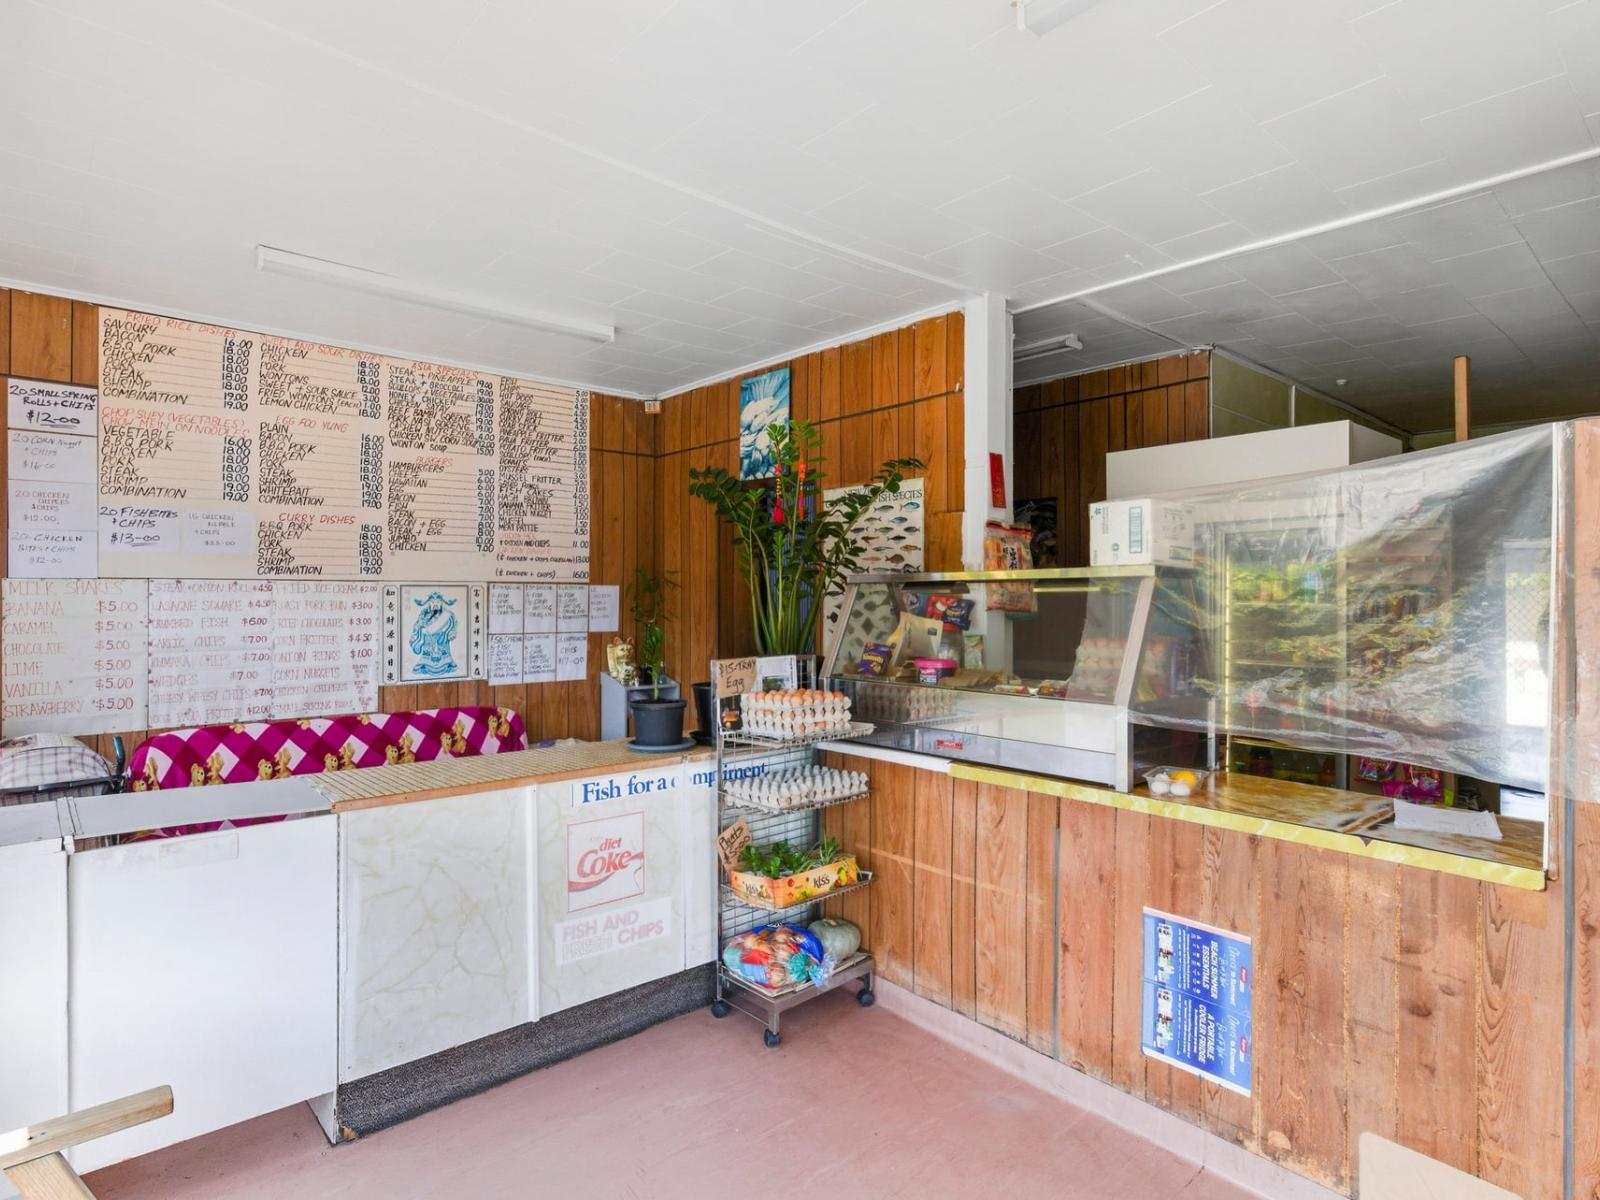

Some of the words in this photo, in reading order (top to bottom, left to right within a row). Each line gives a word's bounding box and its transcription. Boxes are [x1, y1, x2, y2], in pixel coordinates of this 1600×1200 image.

[103, 319, 157, 335] SAVOURY
[224, 338, 253, 348] 16.00
[104, 330, 144, 342] BACON
[224, 347, 250, 357] 18.00
[103, 349, 155, 362] CHICKEN
[223, 365, 248, 375] 18.00
[141, 343, 176, 356] PORK
[223, 356, 249, 366] 18.00
[260, 343, 308, 358] CHICKEN
[357, 361, 380, 369] 18.00
[106, 358, 134, 369] PORK
[222, 373, 247, 384] 18.00
[260, 362, 286, 372] PORK
[357, 377, 380, 386] 18.00
[389, 367, 416, 377] STEAK
[428, 373, 472, 385] PINEAPPLE
[476, 380, 492, 388] 19.00
[103, 367, 144, 380] STEAK
[222, 383, 248, 393] 18.00
[260, 371, 310, 385] WONTONS
[361, 386, 380, 395] 12.00
[10, 385, 28, 396] 20
[29, 389, 60, 398] SMALL
[62, 390, 96, 402] SPRING
[103, 377, 151, 390] SHRIMP
[224, 392, 248, 401] 19.00
[429, 382, 464, 392] BROCCOLI
[476, 389, 493, 397] 19.00
[61, 400, 95, 410] CHIPS
[103, 387, 188, 404] COMBINATION
[224, 401, 248, 411] 19.00
[389, 391, 416, 400] HONEY
[422, 396, 457, 406] CHICKEN
[260, 398, 292, 409] LEMON
[294, 402, 337, 414] CHICKEN
[358, 410, 381, 419] 18.00
[104, 426, 174, 439] VEGETABLE
[224, 437, 252, 448] 16.00
[259, 431, 292, 442] BACON
[361, 443, 383, 451] 18.00
[260, 422, 289, 433] PLAIN
[361, 434, 384, 444] 16.00
[102, 446, 156, 459] CHICKEN
[223, 455, 249, 465] 18.00
[139, 439, 173, 451] PORK
[223, 446, 251, 457] 18.00
[260, 450, 306, 461] CHICKEN
[390, 440, 425, 449] WONTON
[476, 448, 494, 456] 15.00
[101, 456, 134, 466] PORK
[222, 464, 248, 474] 18.00
[260, 467, 295, 477] STEAK
[389, 461, 445, 473] HAMBURGERS
[478, 469, 494, 477] 5.00
[101, 465, 139, 477] STEAK
[222, 474, 249, 483] 18.00
[259, 477, 296, 487] SHRIMP
[532, 475, 561, 484] FRITTER
[101, 485, 187, 498] COMBINATION
[223, 492, 249, 503] 19.00
[223, 483, 250, 493] 19.00
[259, 485, 311, 496] WHITEBAIT
[259, 495, 324, 506] COMBINATION
[362, 500, 382, 509] 19.00
[388, 494, 415, 503] BACON
[99, 506, 117, 516] 20
[279, 512, 315, 523] CURRY
[320, 515, 356, 524] DISHES
[119, 519, 156, 528] CHIPS
[288, 523, 312, 532] PORK
[361, 524, 382, 533] 18.00
[258, 530, 302, 540] CHICKEN
[360, 533, 382, 542] 18.00
[258, 539, 282, 547] PORK
[360, 541, 382, 550] 18.00
[258, 547, 292, 558] STEAK
[359, 549, 382, 558] 18.00
[389, 543, 426, 552] CHICKEN
[476, 545, 494, 553] 7.00
[258, 556, 295, 566] SHRIMP
[360, 558, 382, 567] 19.00
[257, 566, 322, 576] COMBINATION
[360, 566, 382, 575] 19.00
[96, 600, 138, 614] $5.00
[95, 640, 130, 652] $5.00
[94, 659, 131, 672] $5.00
[96, 678, 134, 691] $5.00
[726, 676, 745, 694] Egg
[3, 700, 83, 718] STRAWBERRY
[96, 697, 134, 711] $5.00
[582, 779, 621, 804] Fish
[628, 776, 653, 794] for
[657, 779, 667, 790] a
[599, 837, 622, 851] diet
[577, 849, 632, 879] Coke
[563, 919, 598, 942] FISH
[603, 910, 639, 932] AND
[617, 920, 664, 945] CHIPS
